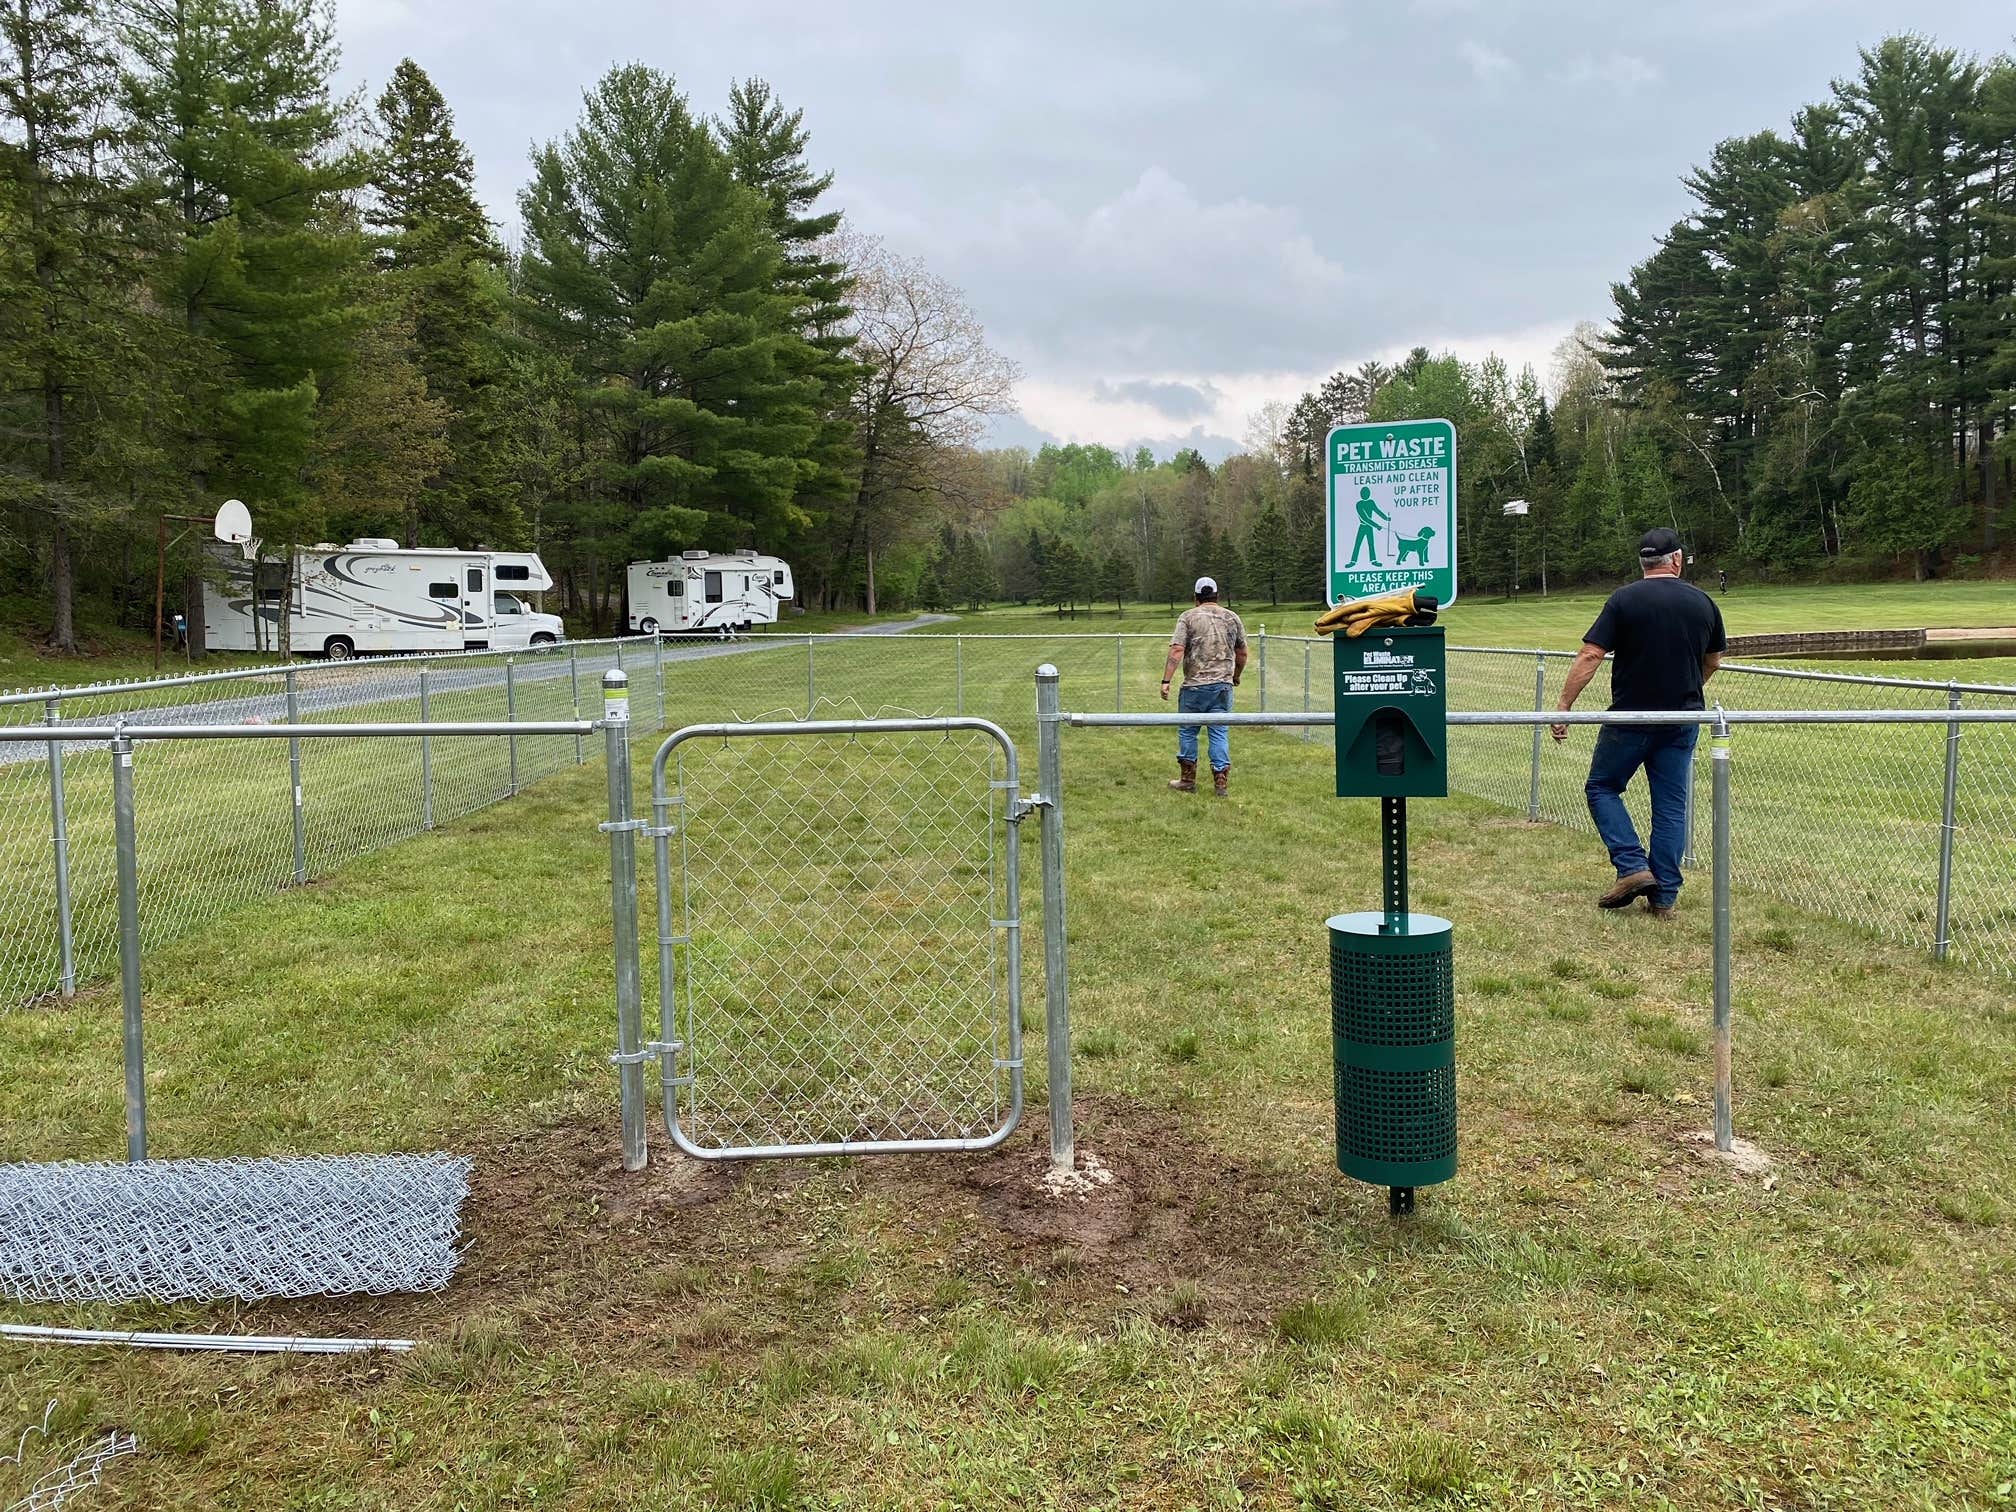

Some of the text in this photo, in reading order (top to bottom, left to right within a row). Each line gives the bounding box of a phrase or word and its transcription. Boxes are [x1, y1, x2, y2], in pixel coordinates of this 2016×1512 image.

[1337, 437, 1445, 460] PET WASTE
[1344, 458, 1438, 473] TRANSMITS DISEASE
[1354, 471, 1439, 485] LEASH AND CLEAN
[1394, 484, 1439, 495] UP AFTER
[1393, 496, 1439, 507] YOUR PET
[1348, 570, 1434, 583] PLEASE KEEP THIS
[1361, 583, 1387, 593] AREA
[1345, 673, 1408, 684] Please Clean Up
[1349, 681, 1405, 692] after your pet.
